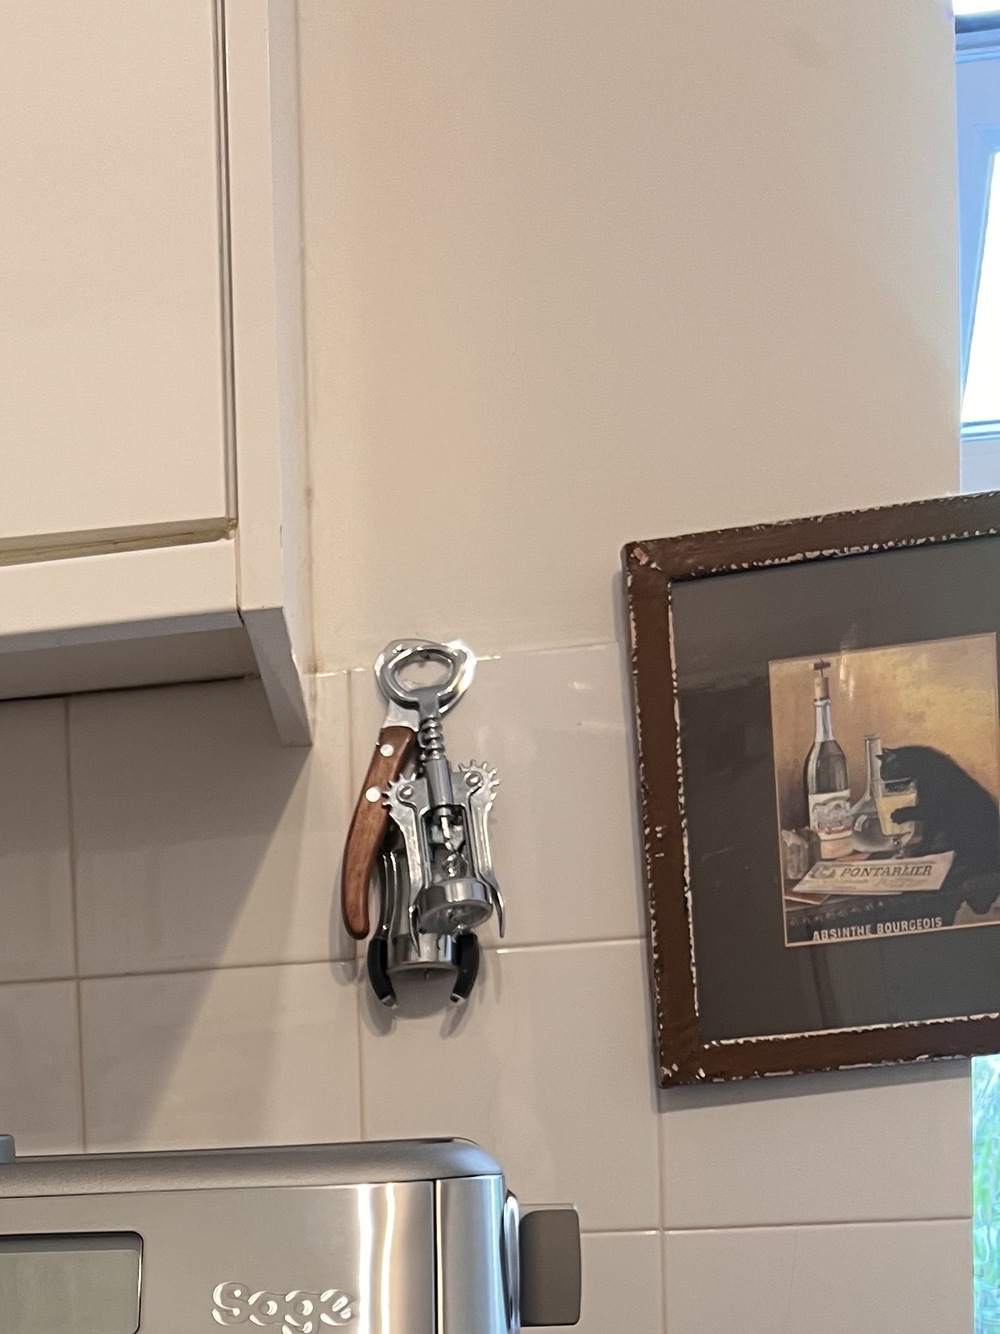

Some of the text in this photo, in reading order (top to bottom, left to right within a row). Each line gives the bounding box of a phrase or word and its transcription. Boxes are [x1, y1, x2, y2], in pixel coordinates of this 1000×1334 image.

[840, 865, 933, 878] PONTARLIER
[812, 917, 943, 942] ABSINTHE BOURGEOIS
